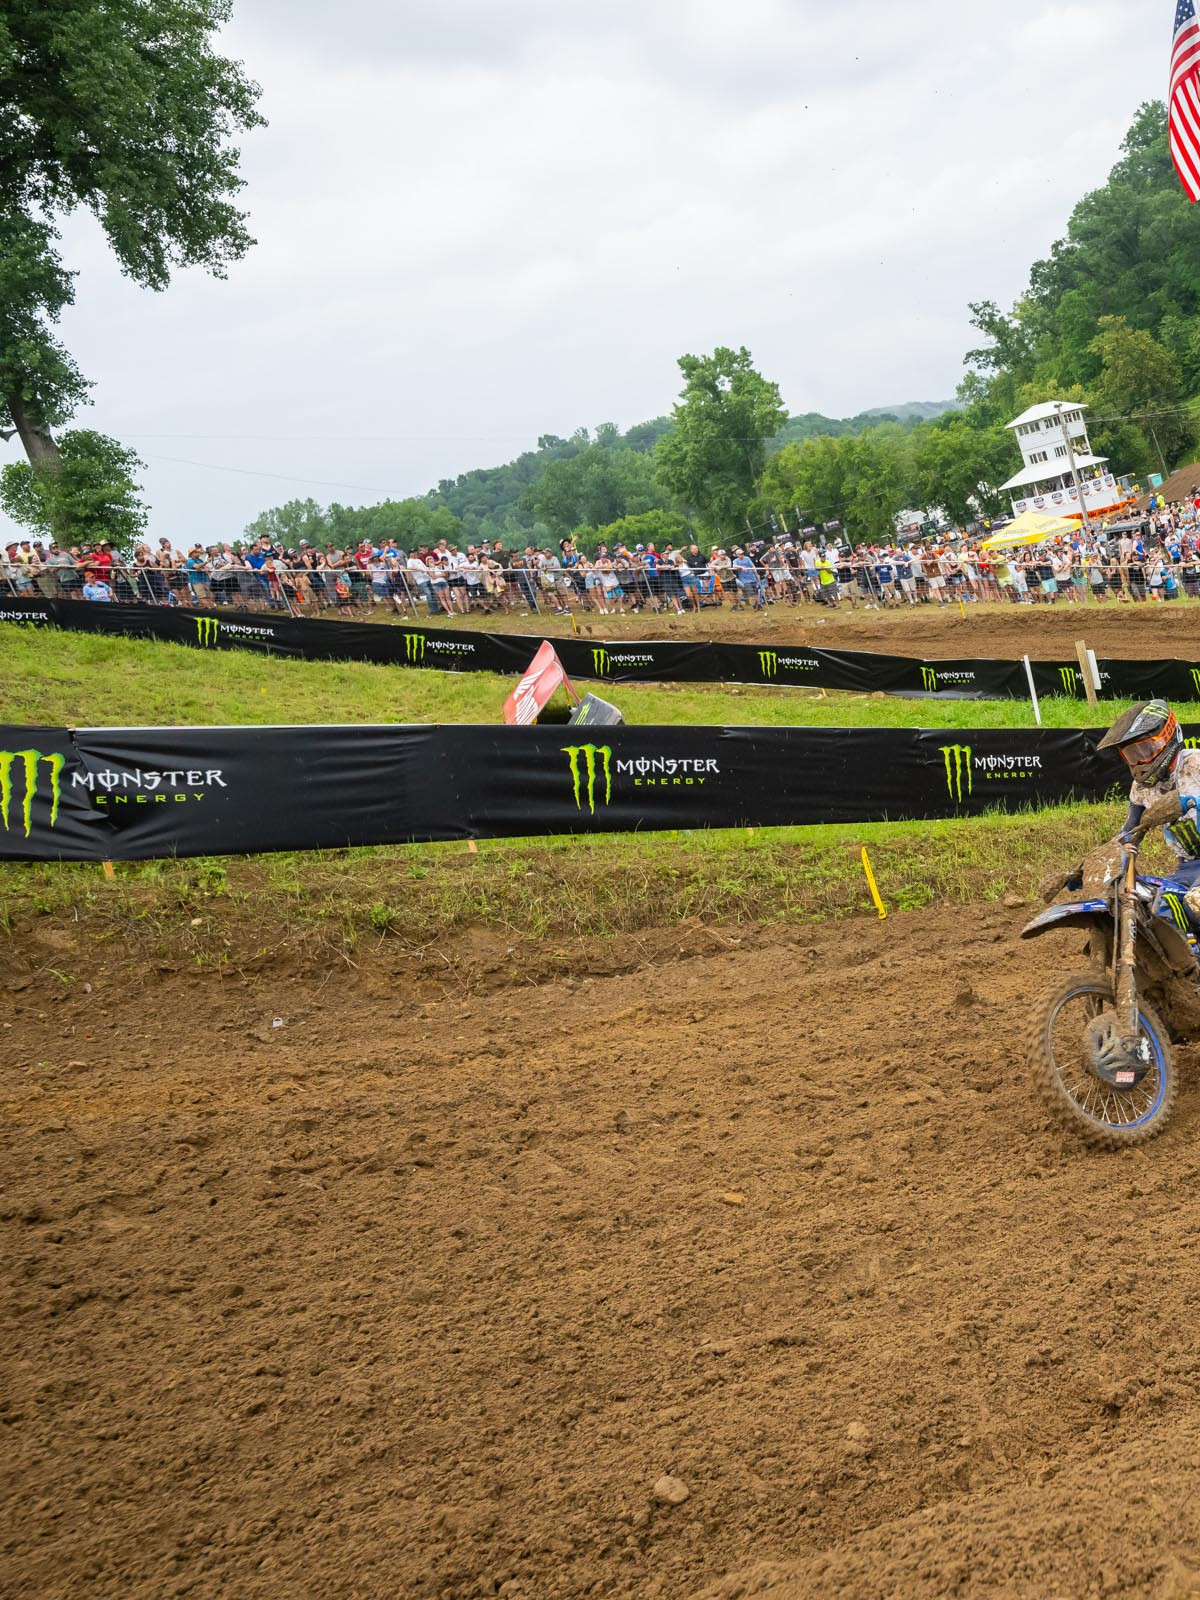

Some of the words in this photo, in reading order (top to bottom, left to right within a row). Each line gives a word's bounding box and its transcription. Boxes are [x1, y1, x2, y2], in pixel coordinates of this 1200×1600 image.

[0, 611, 48, 620] ONSTER
[220, 625, 274, 636] MONSTER
[426, 641, 475, 652] MONSTER
[610, 654, 654, 663] MONSTER
[778, 657, 820, 667] MONSTER
[936, 671, 975, 680] MONSTER
[616, 756, 720, 776] MONSTER
[974, 754, 1043, 771] MONSTER
[71, 768, 227, 792] MONSTER
[986, 771, 1033, 779] ENERGY
[634, 777, 705, 786] ENERGY
[96, 793, 205, 804] ENERGY
